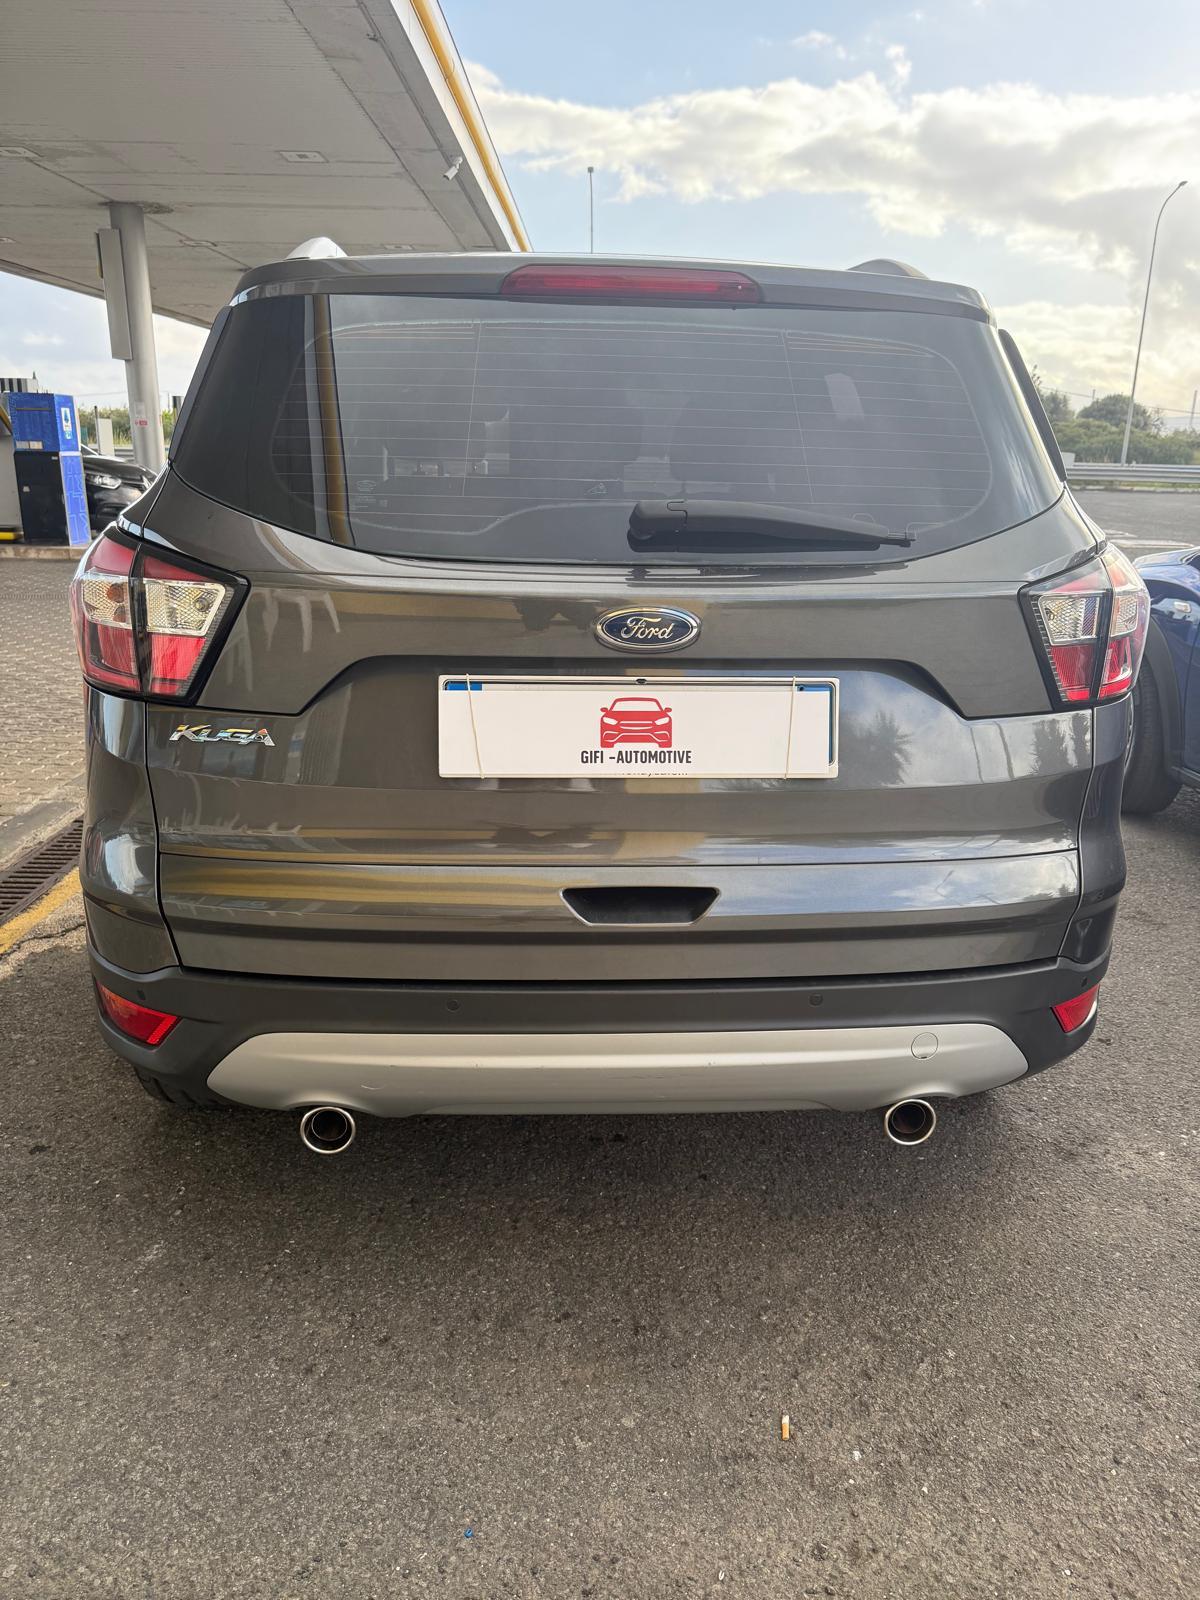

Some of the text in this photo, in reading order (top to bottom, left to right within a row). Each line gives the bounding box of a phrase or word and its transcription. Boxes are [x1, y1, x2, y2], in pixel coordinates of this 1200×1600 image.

[621, 616, 675, 639] Ford
[168, 724, 276, 747] KUGA
[580, 750, 604, 764] GIFI
